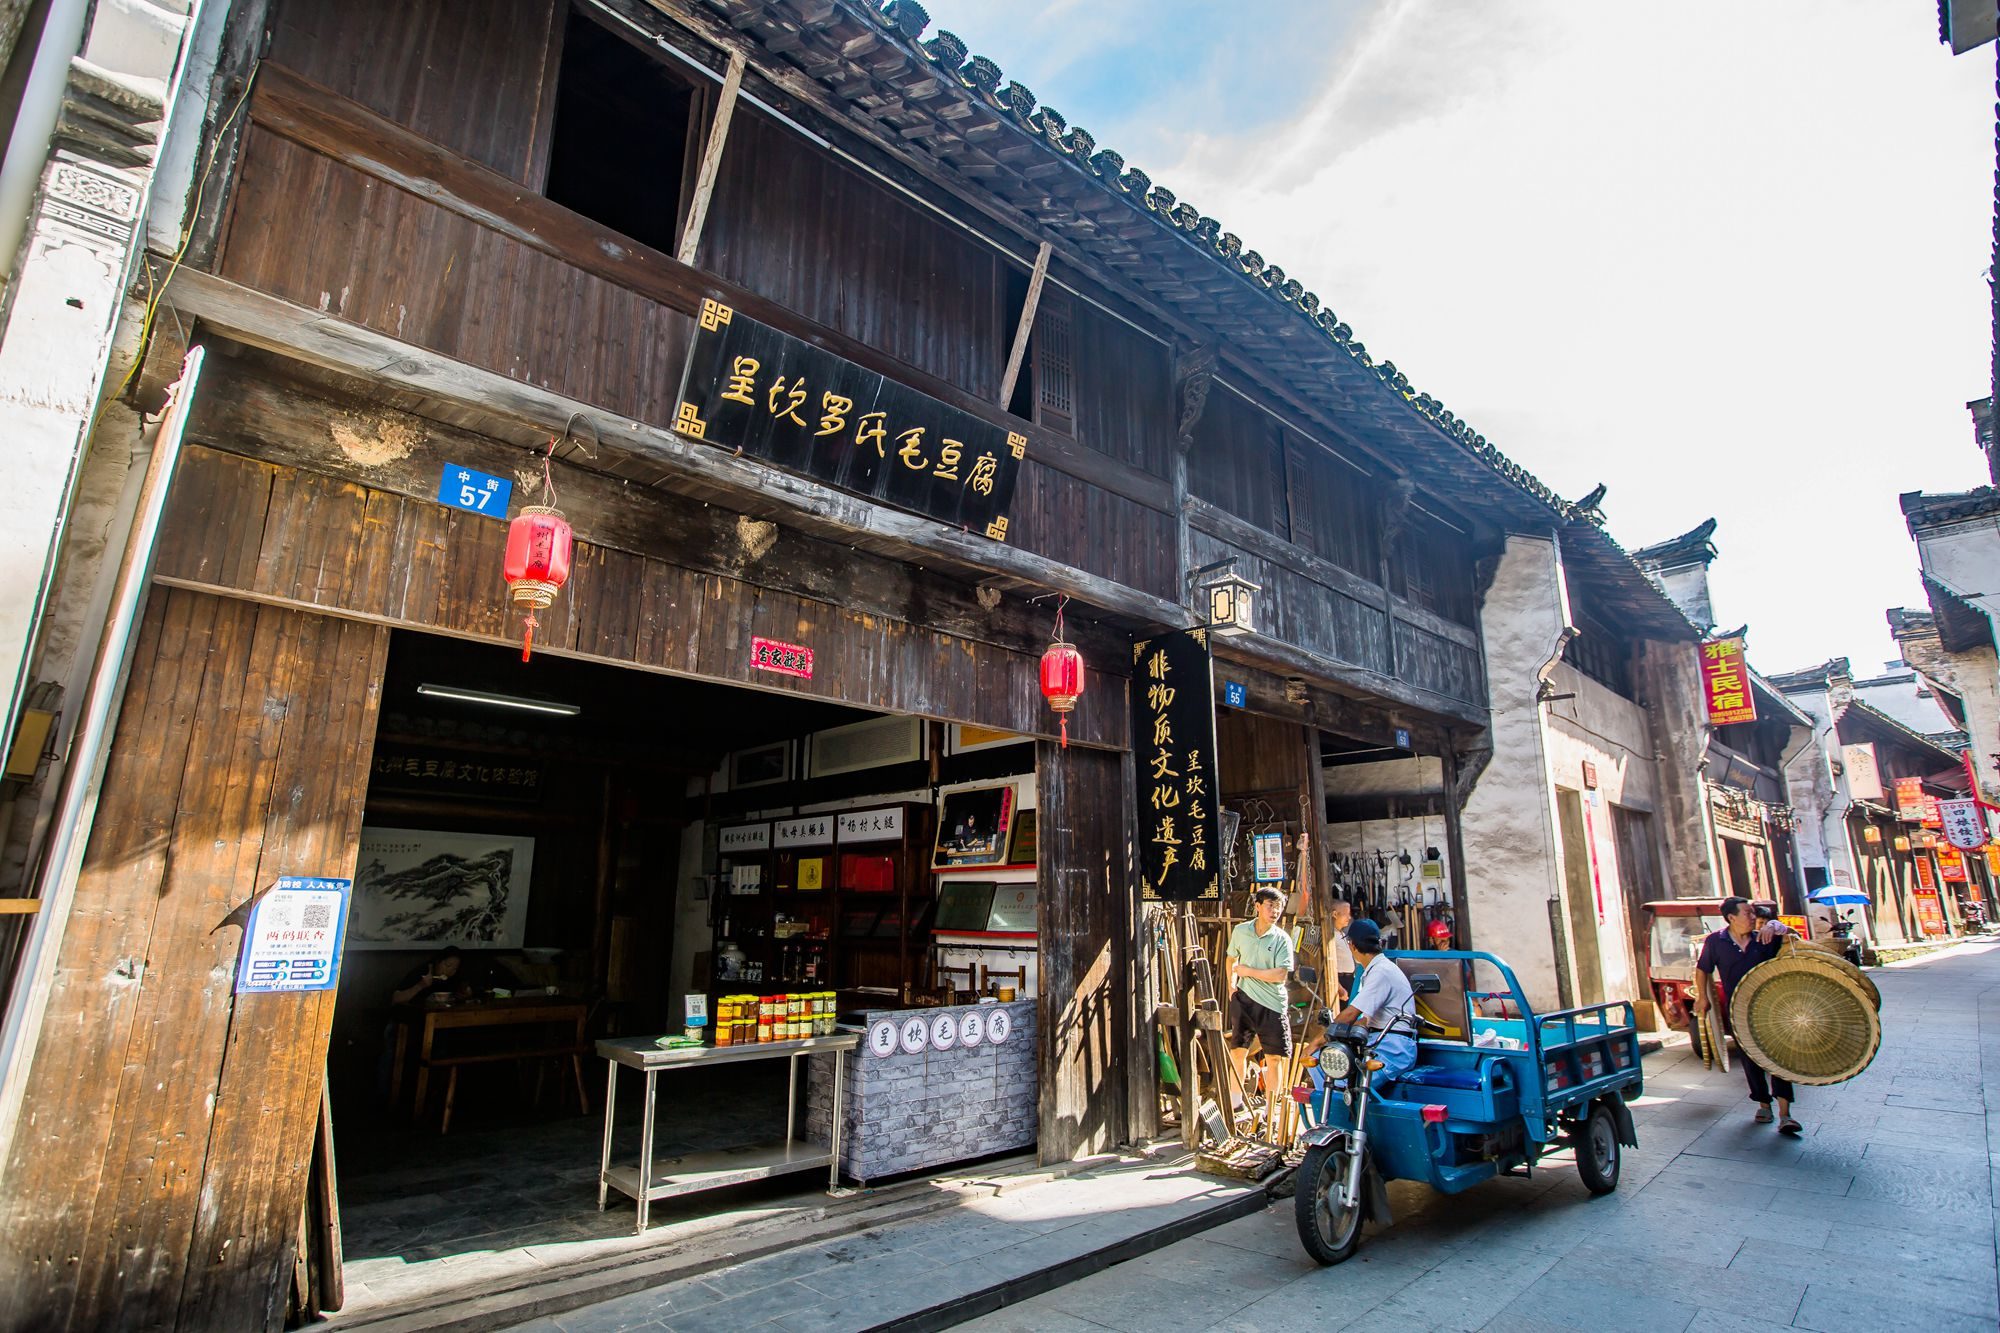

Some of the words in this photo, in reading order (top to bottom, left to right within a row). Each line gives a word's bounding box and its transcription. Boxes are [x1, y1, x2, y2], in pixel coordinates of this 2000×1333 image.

[720, 355, 998, 497] 呈坎罗氏毛豆腐
[458, 471, 499, 492] 中街
[459, 485, 492, 510] 57
[1230, 691, 1240, 705] 55
[1704, 641, 1744, 710] 雅士民宿
[1148, 649, 1182, 886] 非物质文化遗产
[1186, 750, 1206, 871] 呈坎毛豆腐
[879, 1016, 1006, 1047] 呈坎毛豆腐
